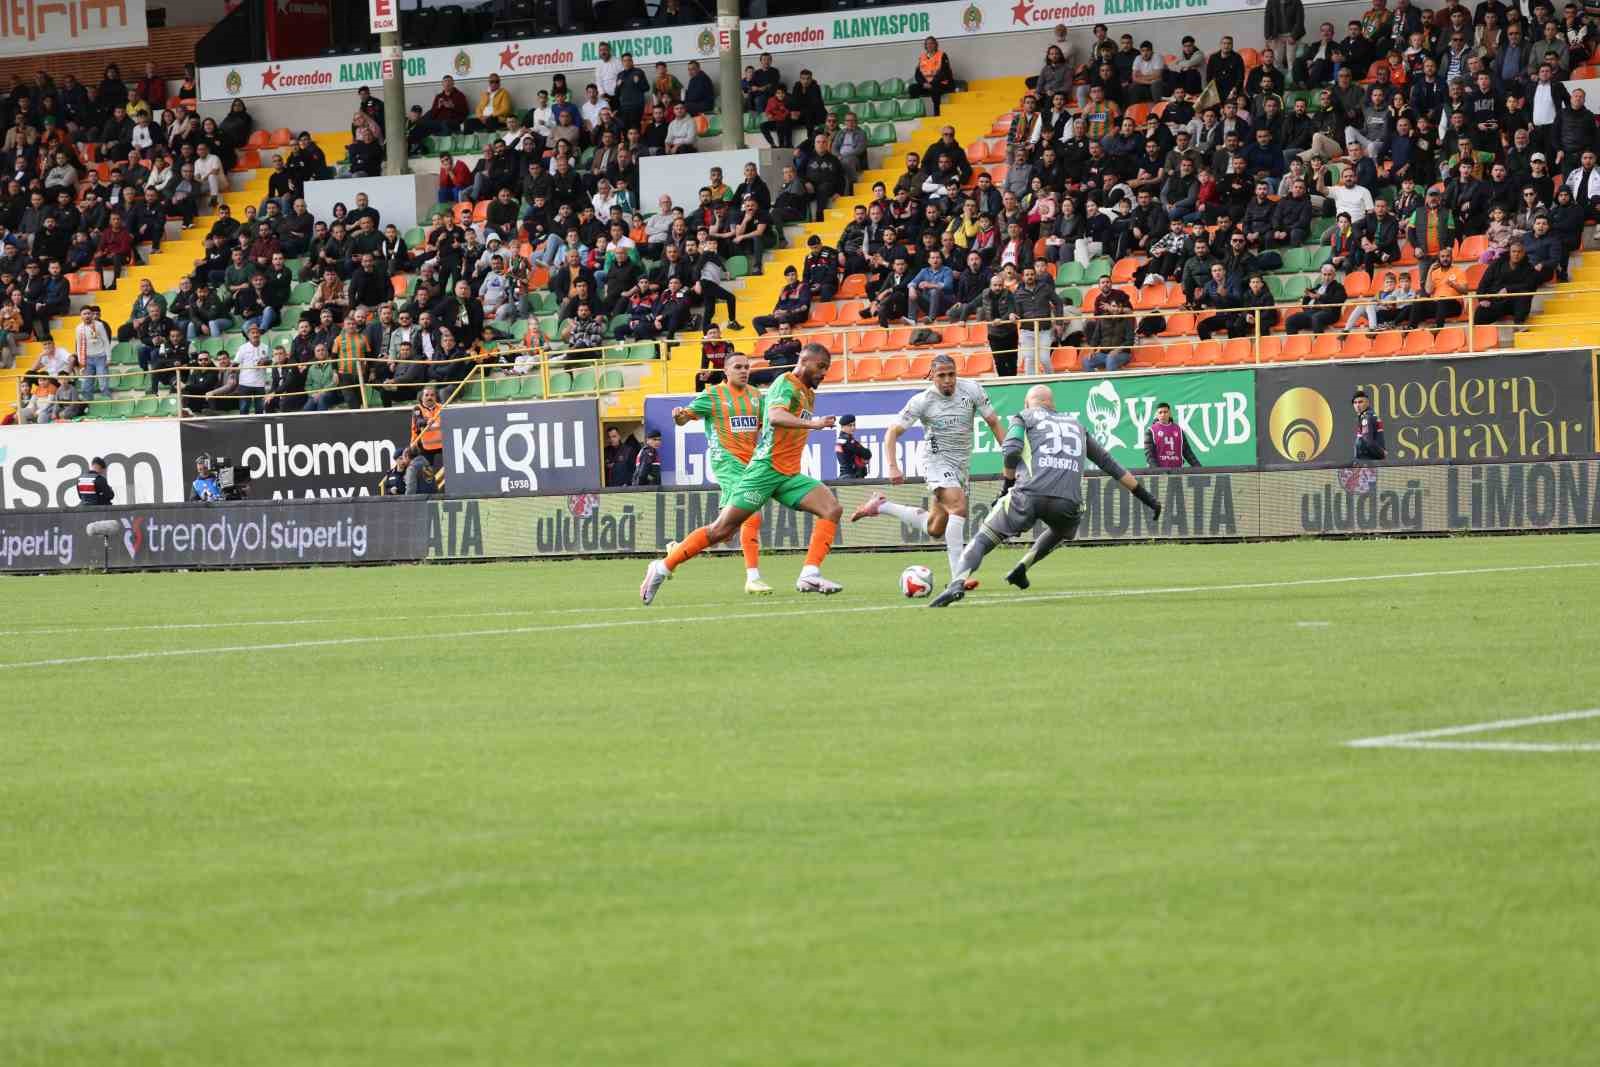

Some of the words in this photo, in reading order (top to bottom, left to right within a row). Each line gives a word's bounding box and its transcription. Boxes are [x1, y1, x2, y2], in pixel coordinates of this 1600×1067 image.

[766, 26, 824, 45] corendon
[833, 12, 930, 39] ALANYASPOR
[1033, 2, 1094, 21] corendon
[518, 44, 573, 66] corendon
[581, 35, 672, 61] ALNYASPOR
[280, 70, 331, 87] corendon
[1037, 419, 1081, 457] 35
[1125, 391, 1250, 452] YKUB
[241, 423, 397, 479] ottoman
[147, 514, 267, 559] trendyol
[271, 517, 367, 556] süperLig
[536, 504, 636, 553] uludağ
